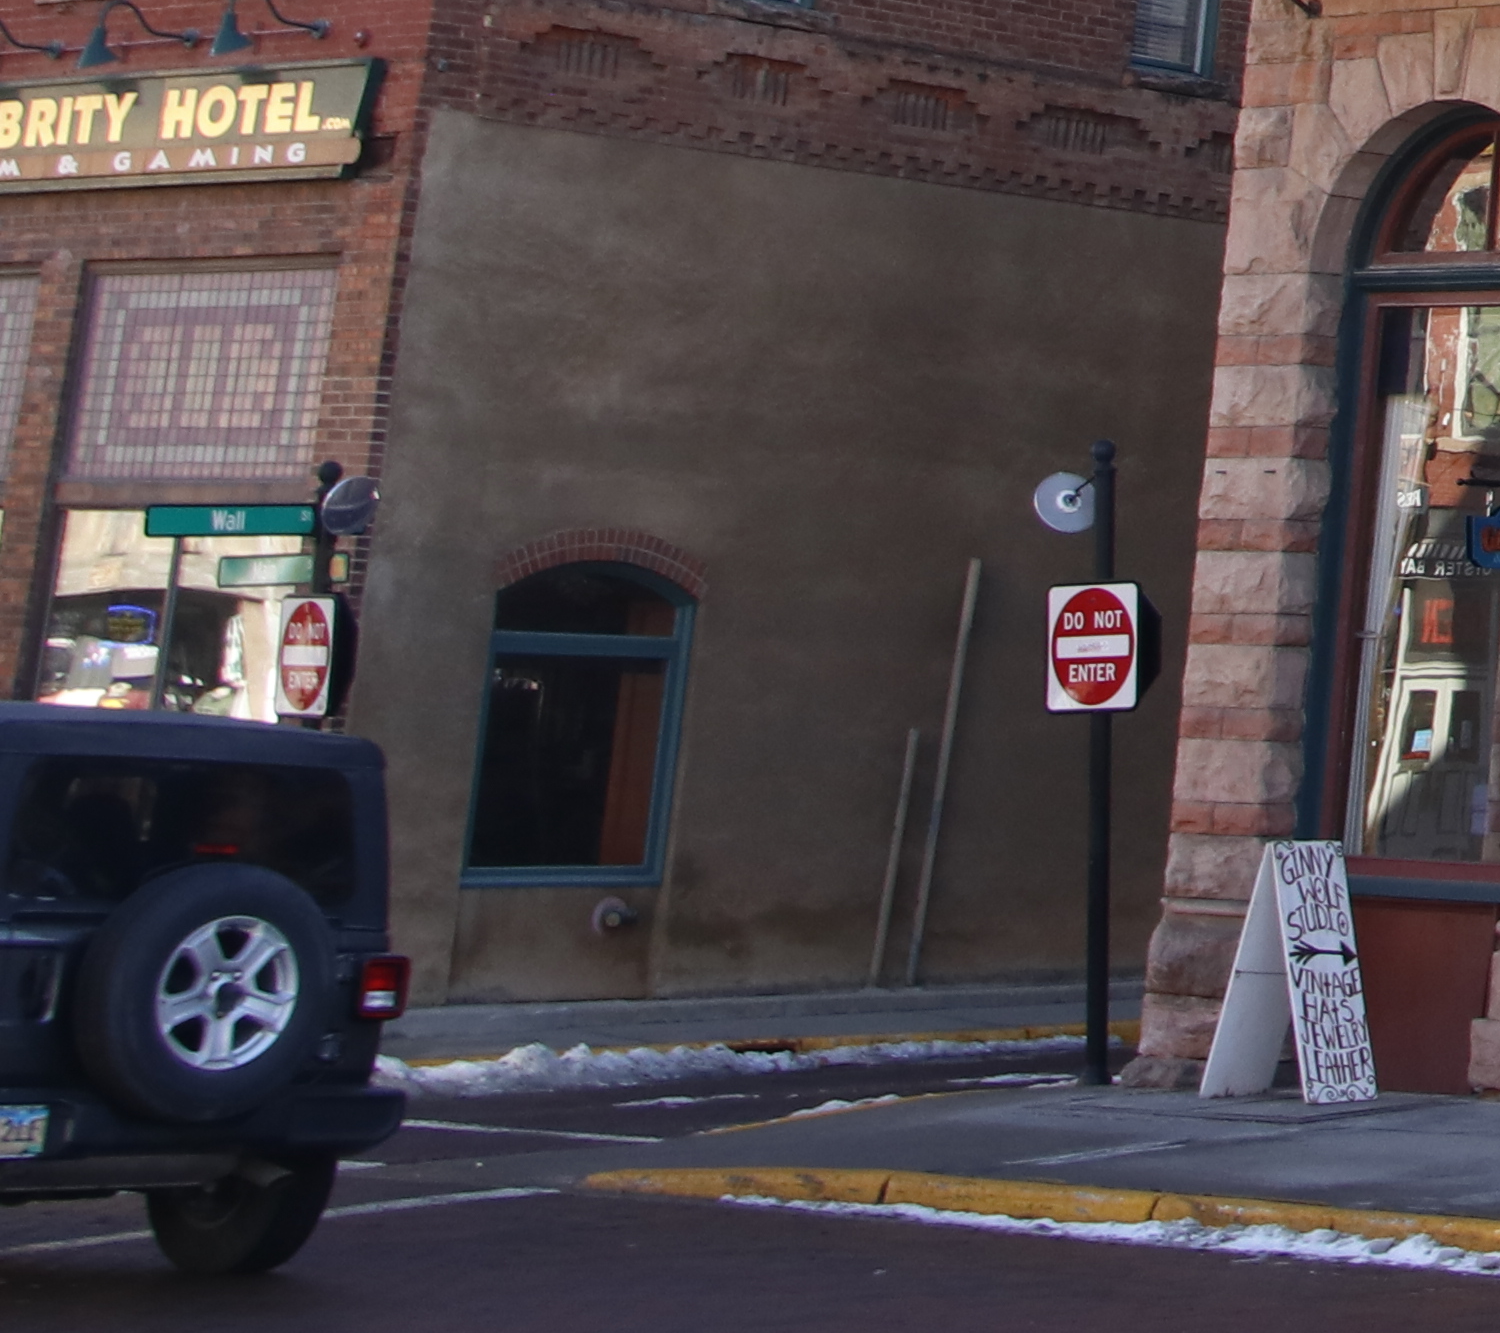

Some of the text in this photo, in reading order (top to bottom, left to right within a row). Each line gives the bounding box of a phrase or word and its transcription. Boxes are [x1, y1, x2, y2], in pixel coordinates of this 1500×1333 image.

[159, 80, 320, 138] HOTEL
[57, 154, 78, 175] &
[113, 142, 307, 171] GAMING
[212, 510, 245, 531] Wall
[288, 622, 326, 640] DO NOT
[1063, 609, 1123, 631] DO NOT
[289, 671, 319, 690] ENTER
[1068, 662, 1117, 683] ENTER
[1280, 844, 1335, 886] GINNY
[1296, 876, 1345, 910] WOLF
[1287, 903, 1350, 942] STUDIO
[1289, 962, 1363, 999] VINTAGE
[1301, 992, 1355, 1024] HATS
[1300, 1013, 1368, 1051] JEWELRY
[1302, 1043, 1372, 1085] LEATHER
